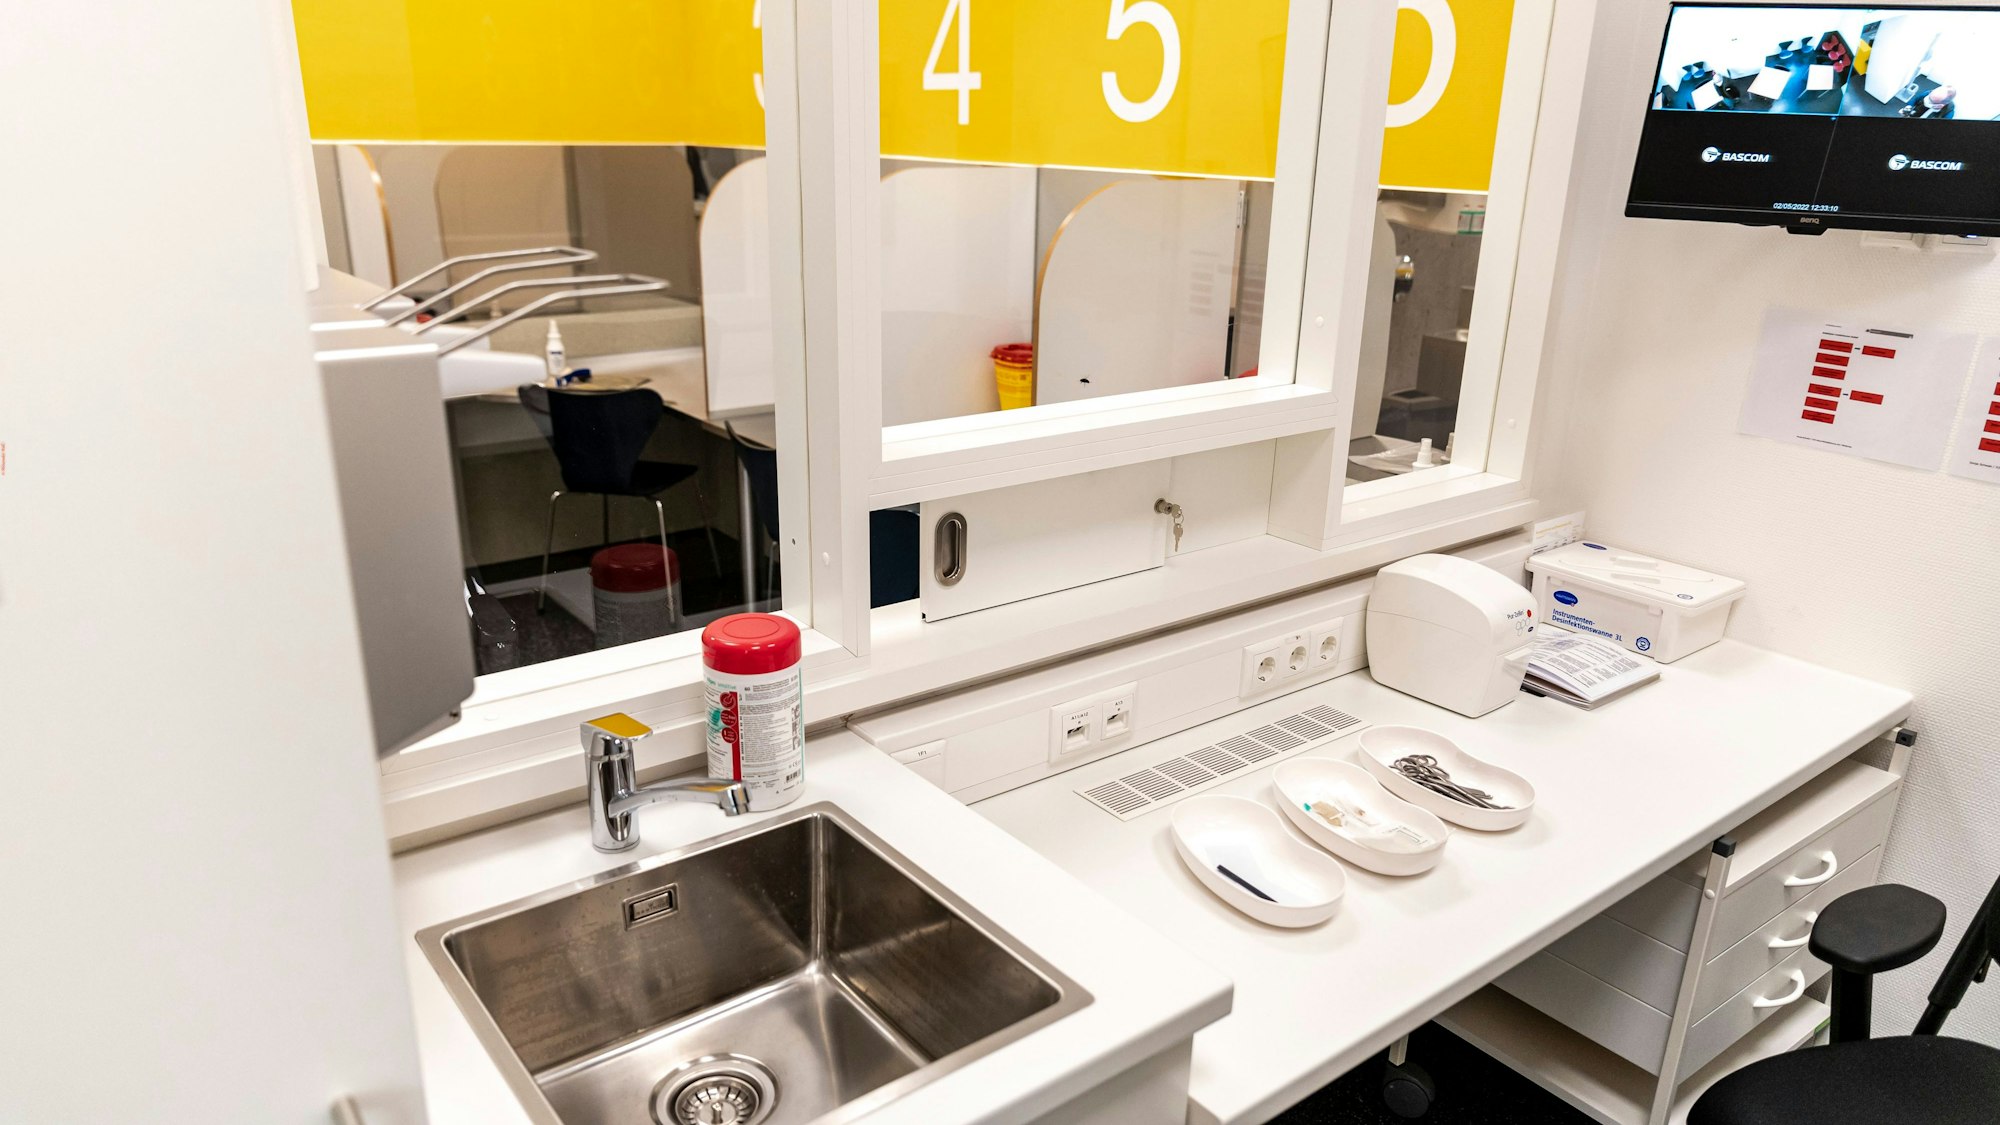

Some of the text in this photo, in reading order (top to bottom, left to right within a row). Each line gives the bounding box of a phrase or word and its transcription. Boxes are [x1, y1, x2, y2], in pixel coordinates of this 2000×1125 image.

[922, 0, 1181, 126] 4 5
[1721, 152, 1770, 163] BASCOM
[1909, 159, 1962, 171] BASCOM
[1772, 202, 1839, 212] 02/05/2022 12:33:10
[1552, 608, 1596, 626] Instrumenten-
[1552, 614, 1614, 639] Desinfektionswanne
